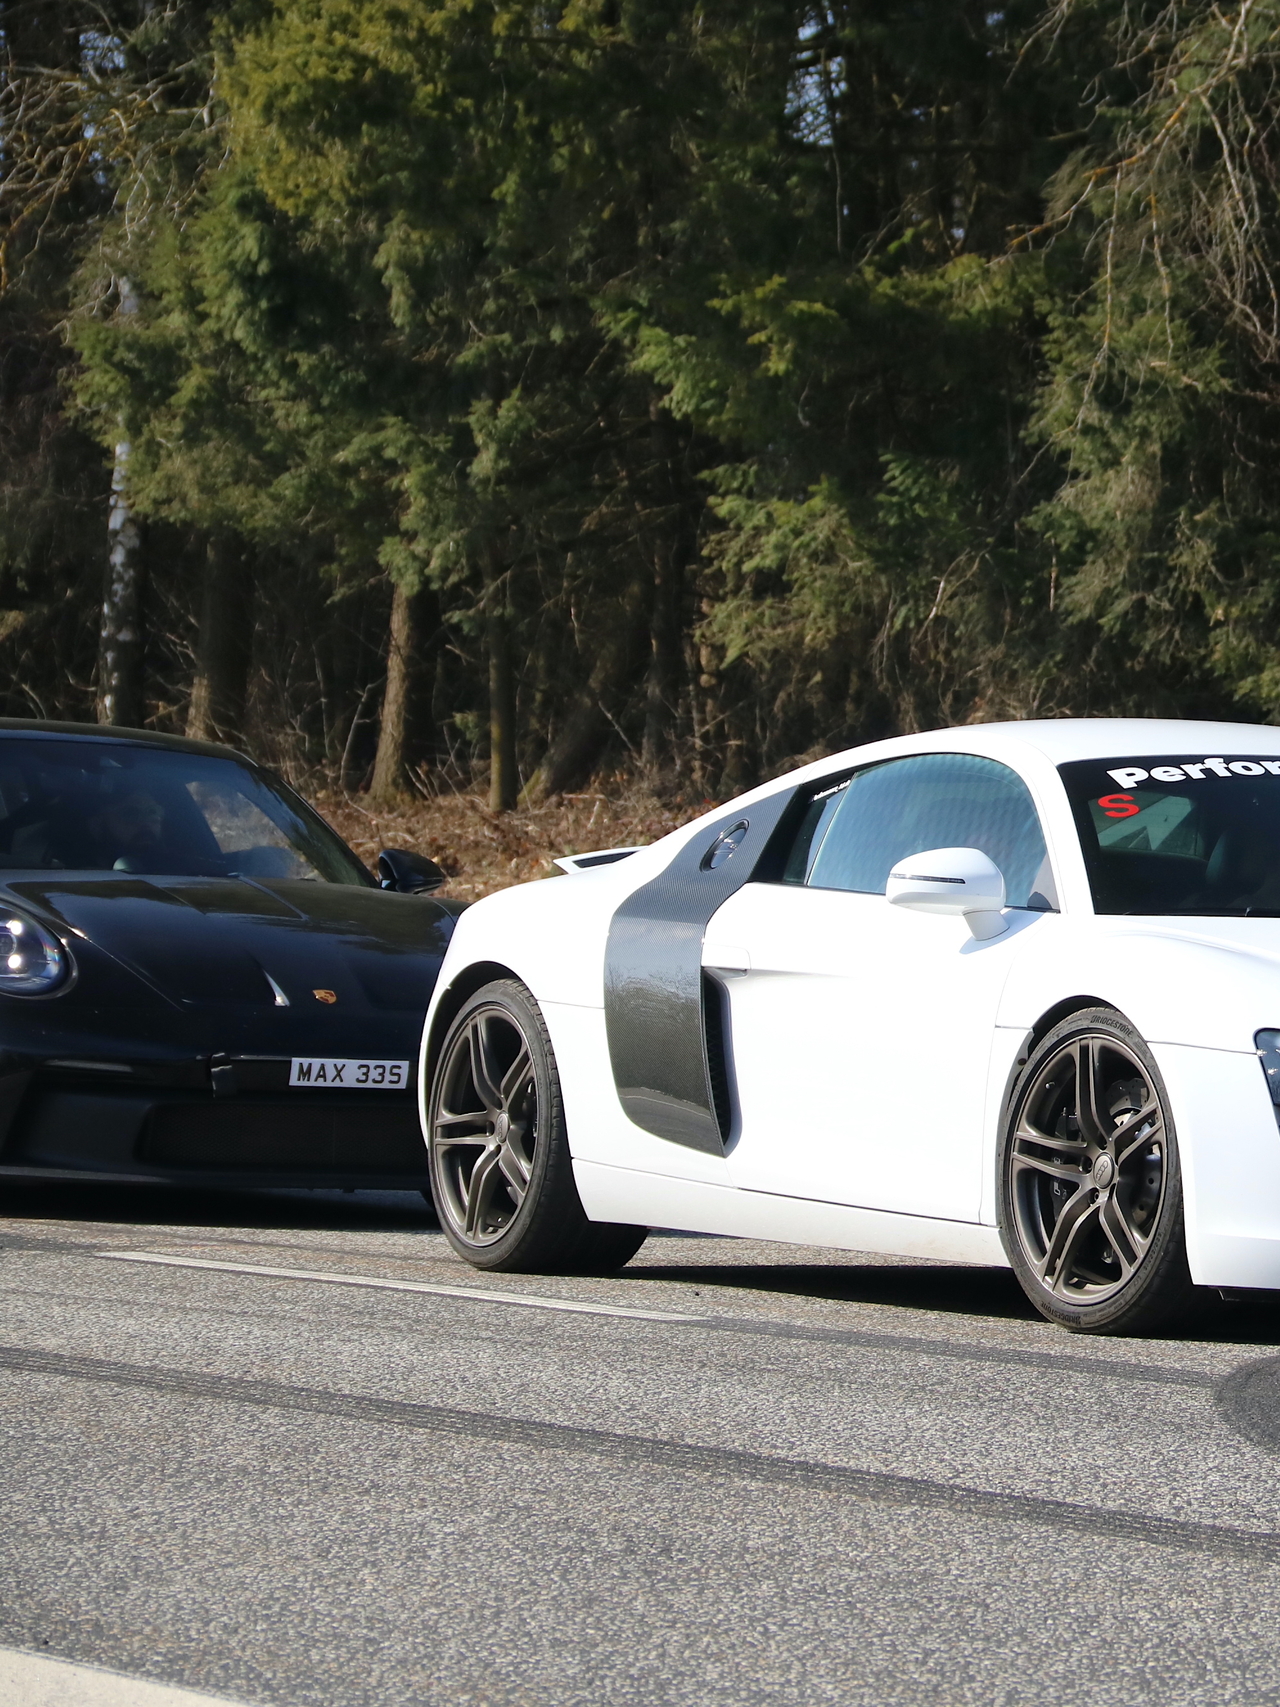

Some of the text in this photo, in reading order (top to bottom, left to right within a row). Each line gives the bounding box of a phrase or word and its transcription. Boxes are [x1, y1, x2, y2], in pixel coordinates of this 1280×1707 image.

[1097, 793, 1140, 818] S
[1090, 1014, 1134, 1038] BRIDGESTONE
[297, 1062, 346, 1083] MAX
